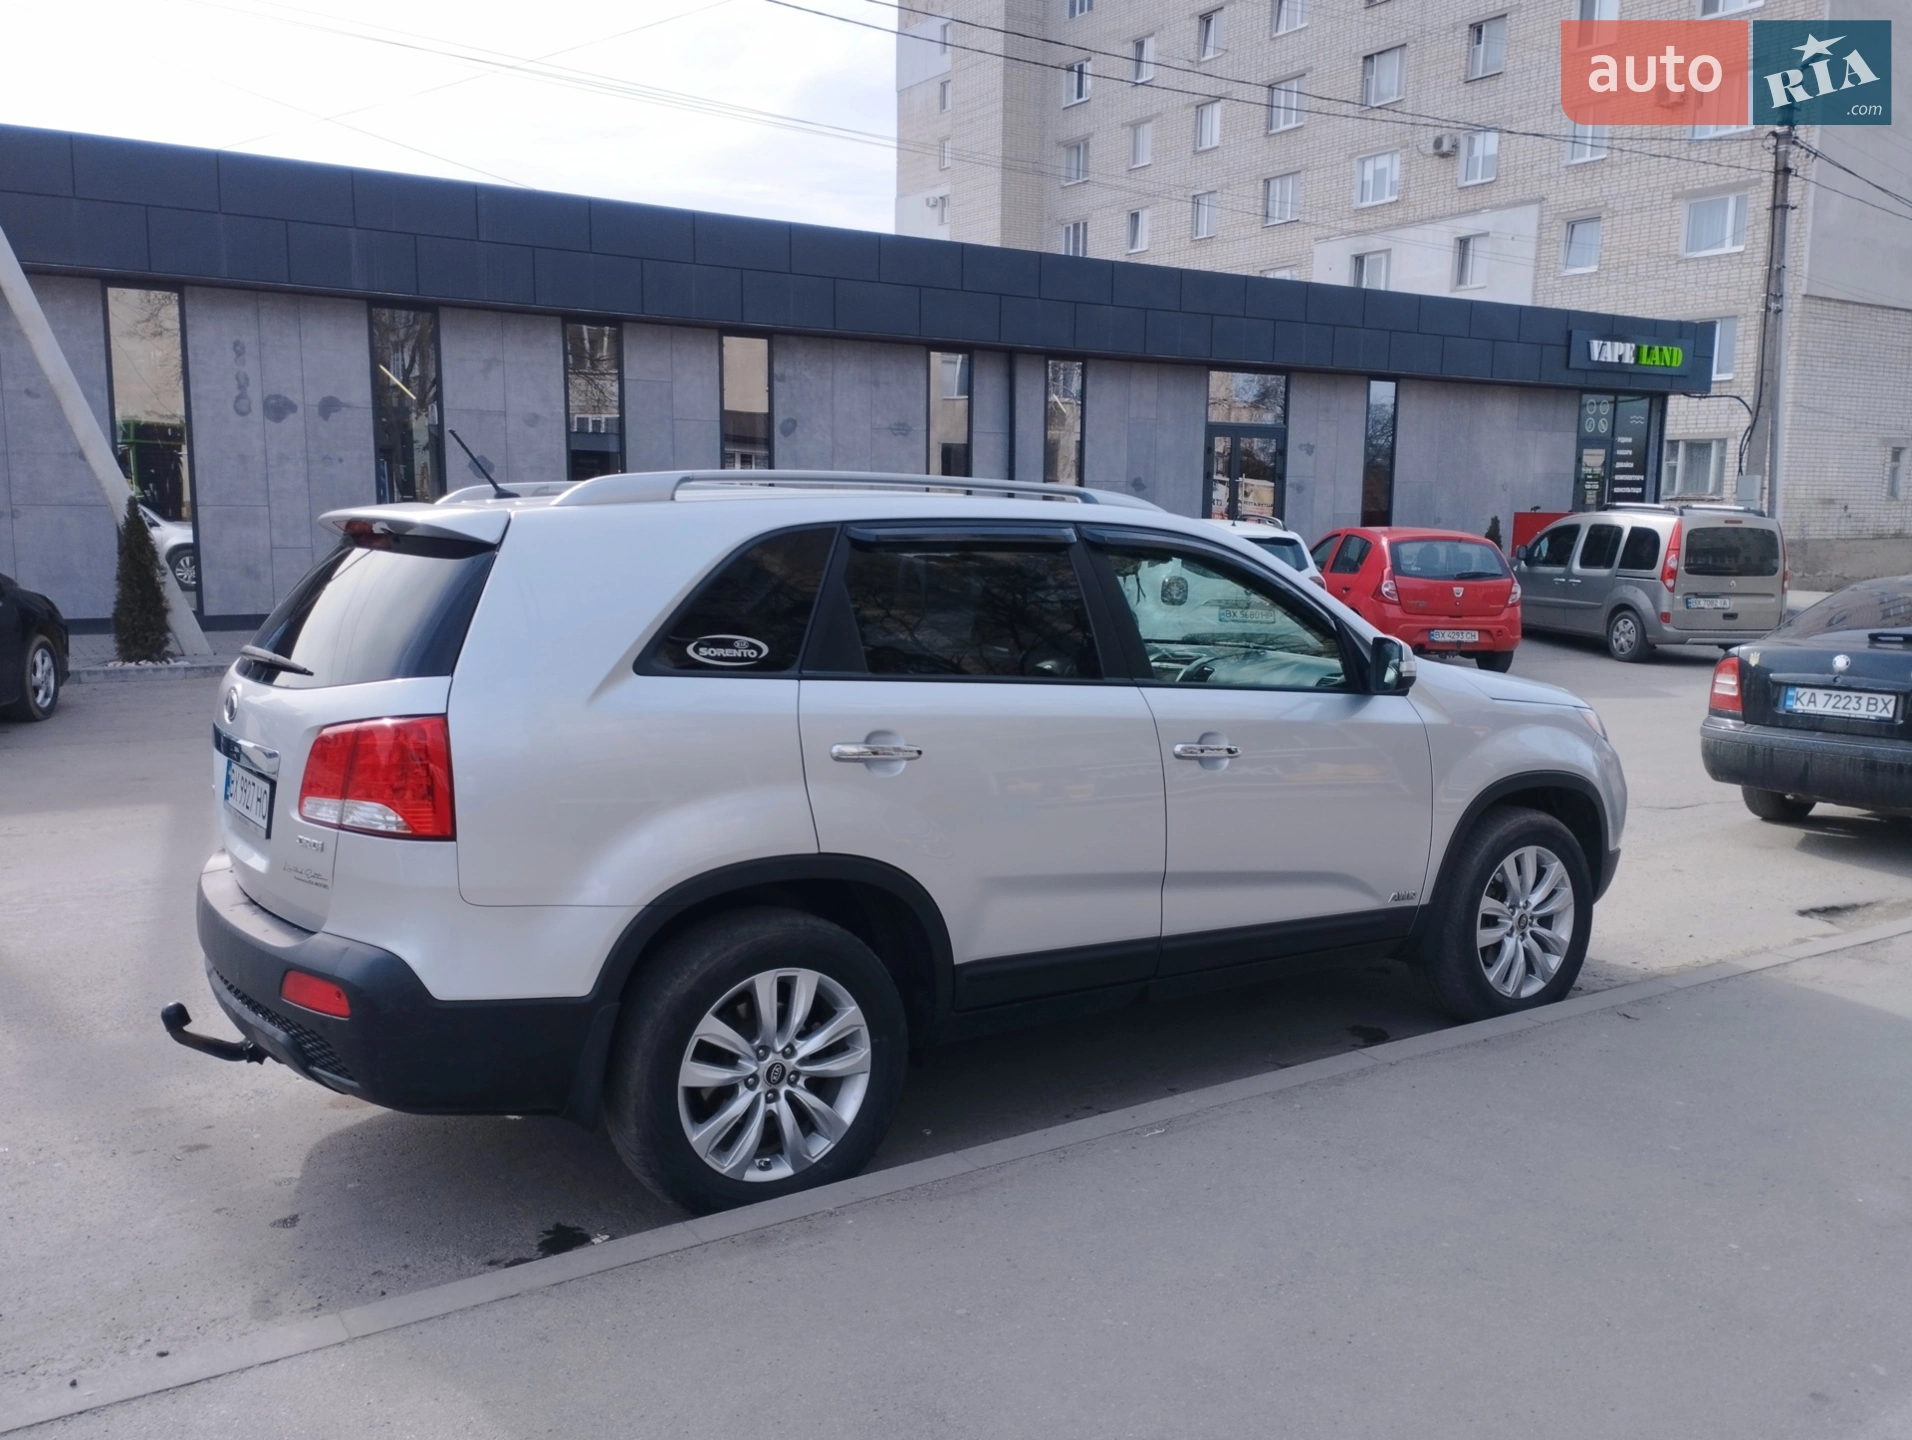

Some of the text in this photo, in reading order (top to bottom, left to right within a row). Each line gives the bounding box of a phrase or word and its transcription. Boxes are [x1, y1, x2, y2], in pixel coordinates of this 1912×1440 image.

[1588, 339, 1683, 367] VAPE LAND
[1225, 609, 1238, 619] BX
[1240, 610, 1260, 619] 5680
[1434, 631, 1477, 640] BX 4293 CH
[698, 647, 758, 658] SORENTO
[1795, 691, 1894, 715] KA 7223 BX
[239, 775, 256, 812] 9927
[255, 784, 268, 820] HO
